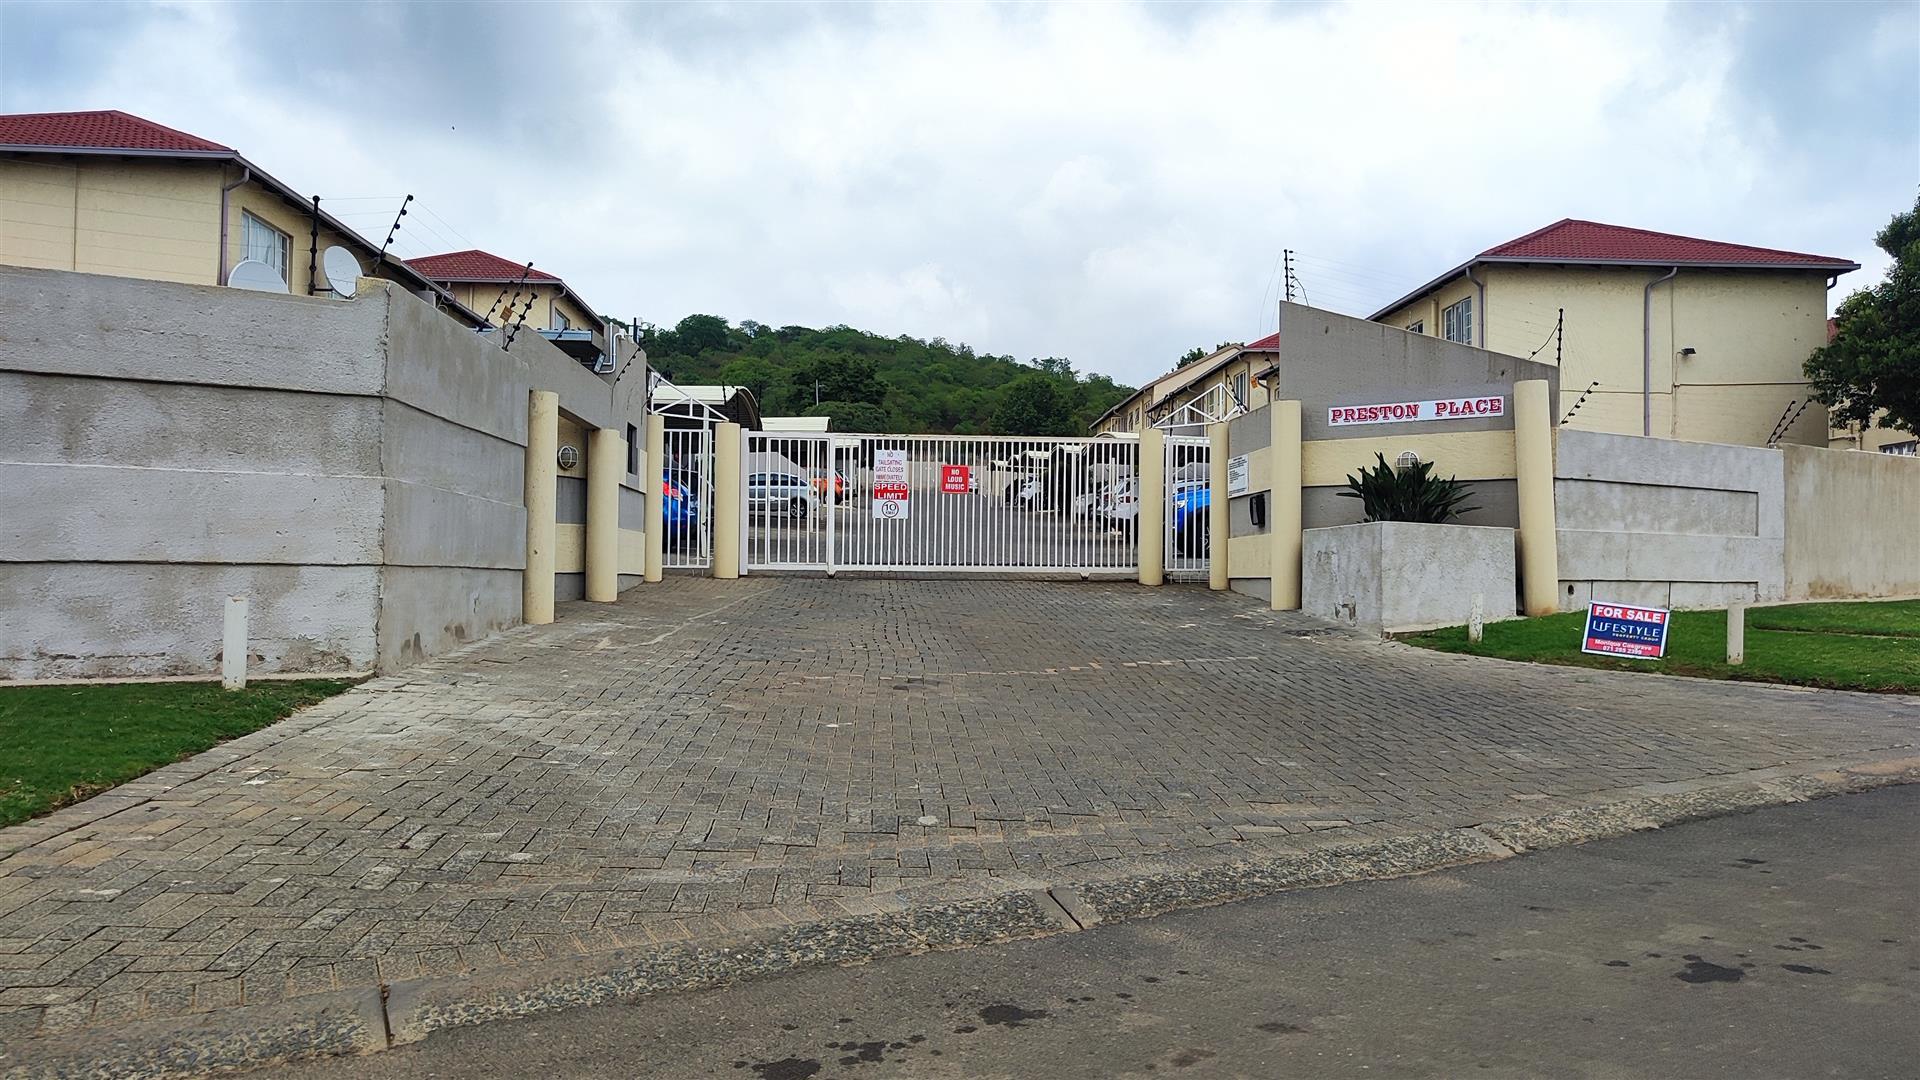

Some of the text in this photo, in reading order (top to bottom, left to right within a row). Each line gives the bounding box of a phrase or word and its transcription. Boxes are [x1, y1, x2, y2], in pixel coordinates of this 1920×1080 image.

[1331, 398, 1503, 423] PRESTON PLACE
[877, 492, 904, 500] LIMIT
[885, 503, 897, 511] 10
[1595, 605, 1661, 623] FOR SALE
[1592, 620, 1661, 637] LIFESTYLE
